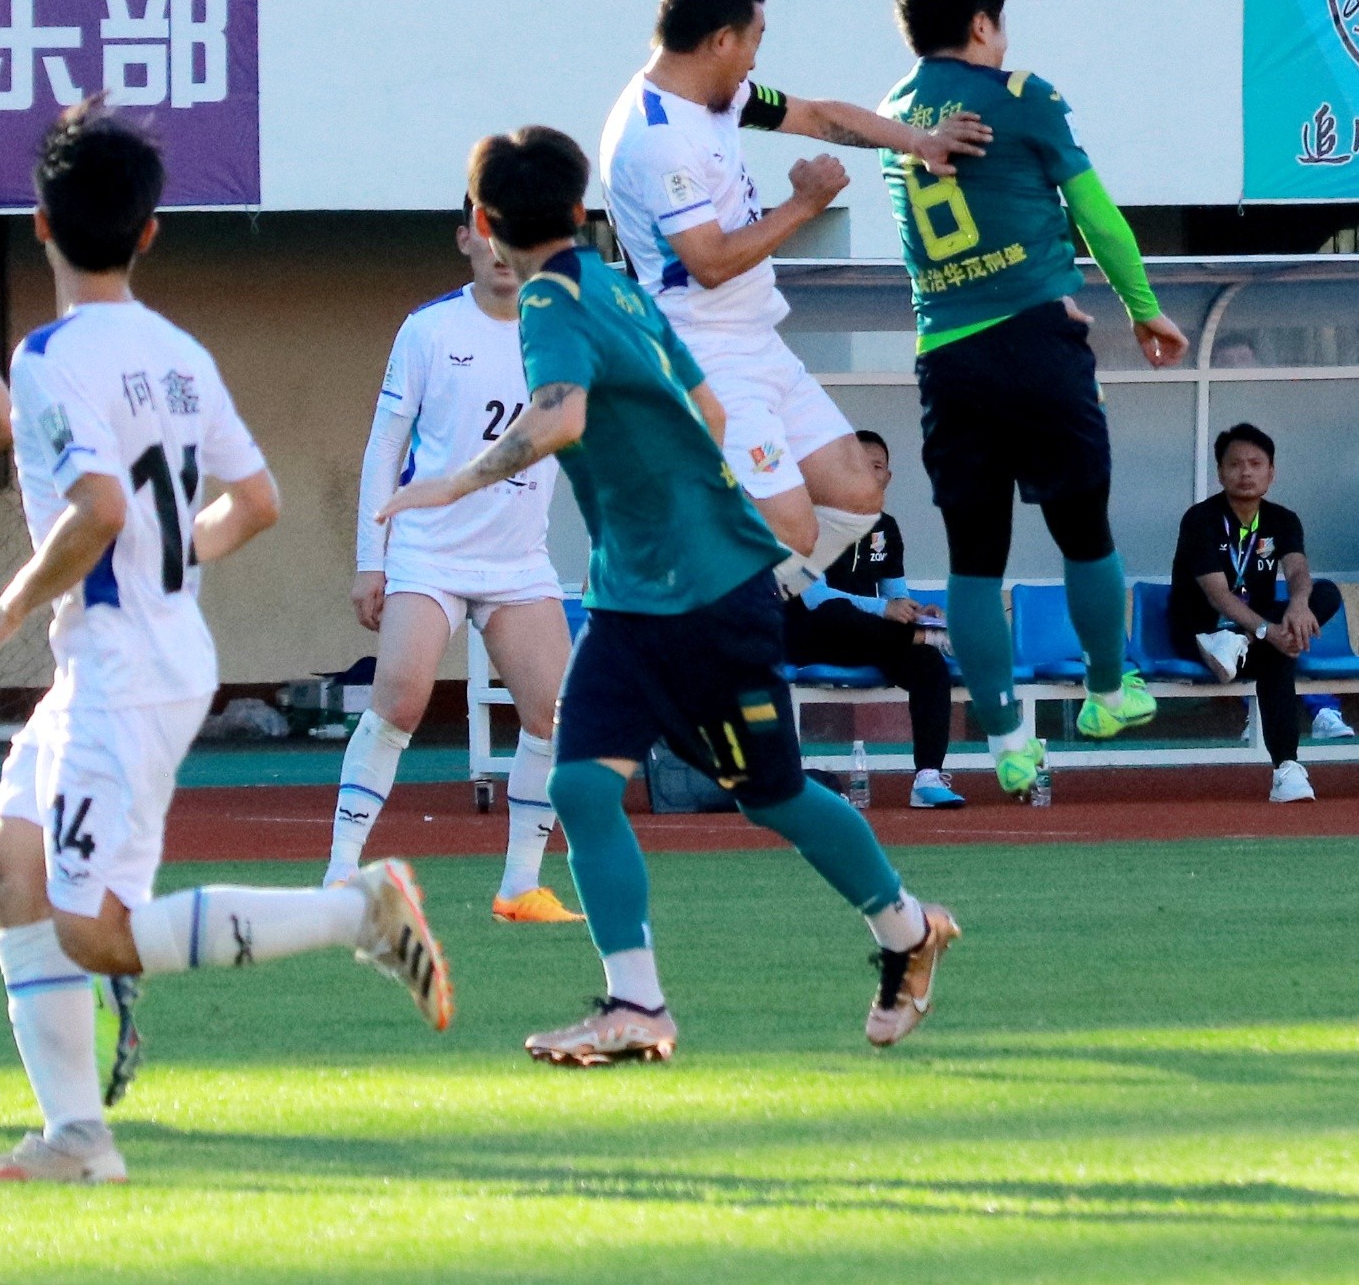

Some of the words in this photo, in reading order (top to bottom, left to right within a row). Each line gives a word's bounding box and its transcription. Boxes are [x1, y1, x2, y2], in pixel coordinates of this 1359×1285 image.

[899, 147, 980, 262] 6
[121, 369, 201, 417] 何鑫
[50, 793, 96, 861] 14
